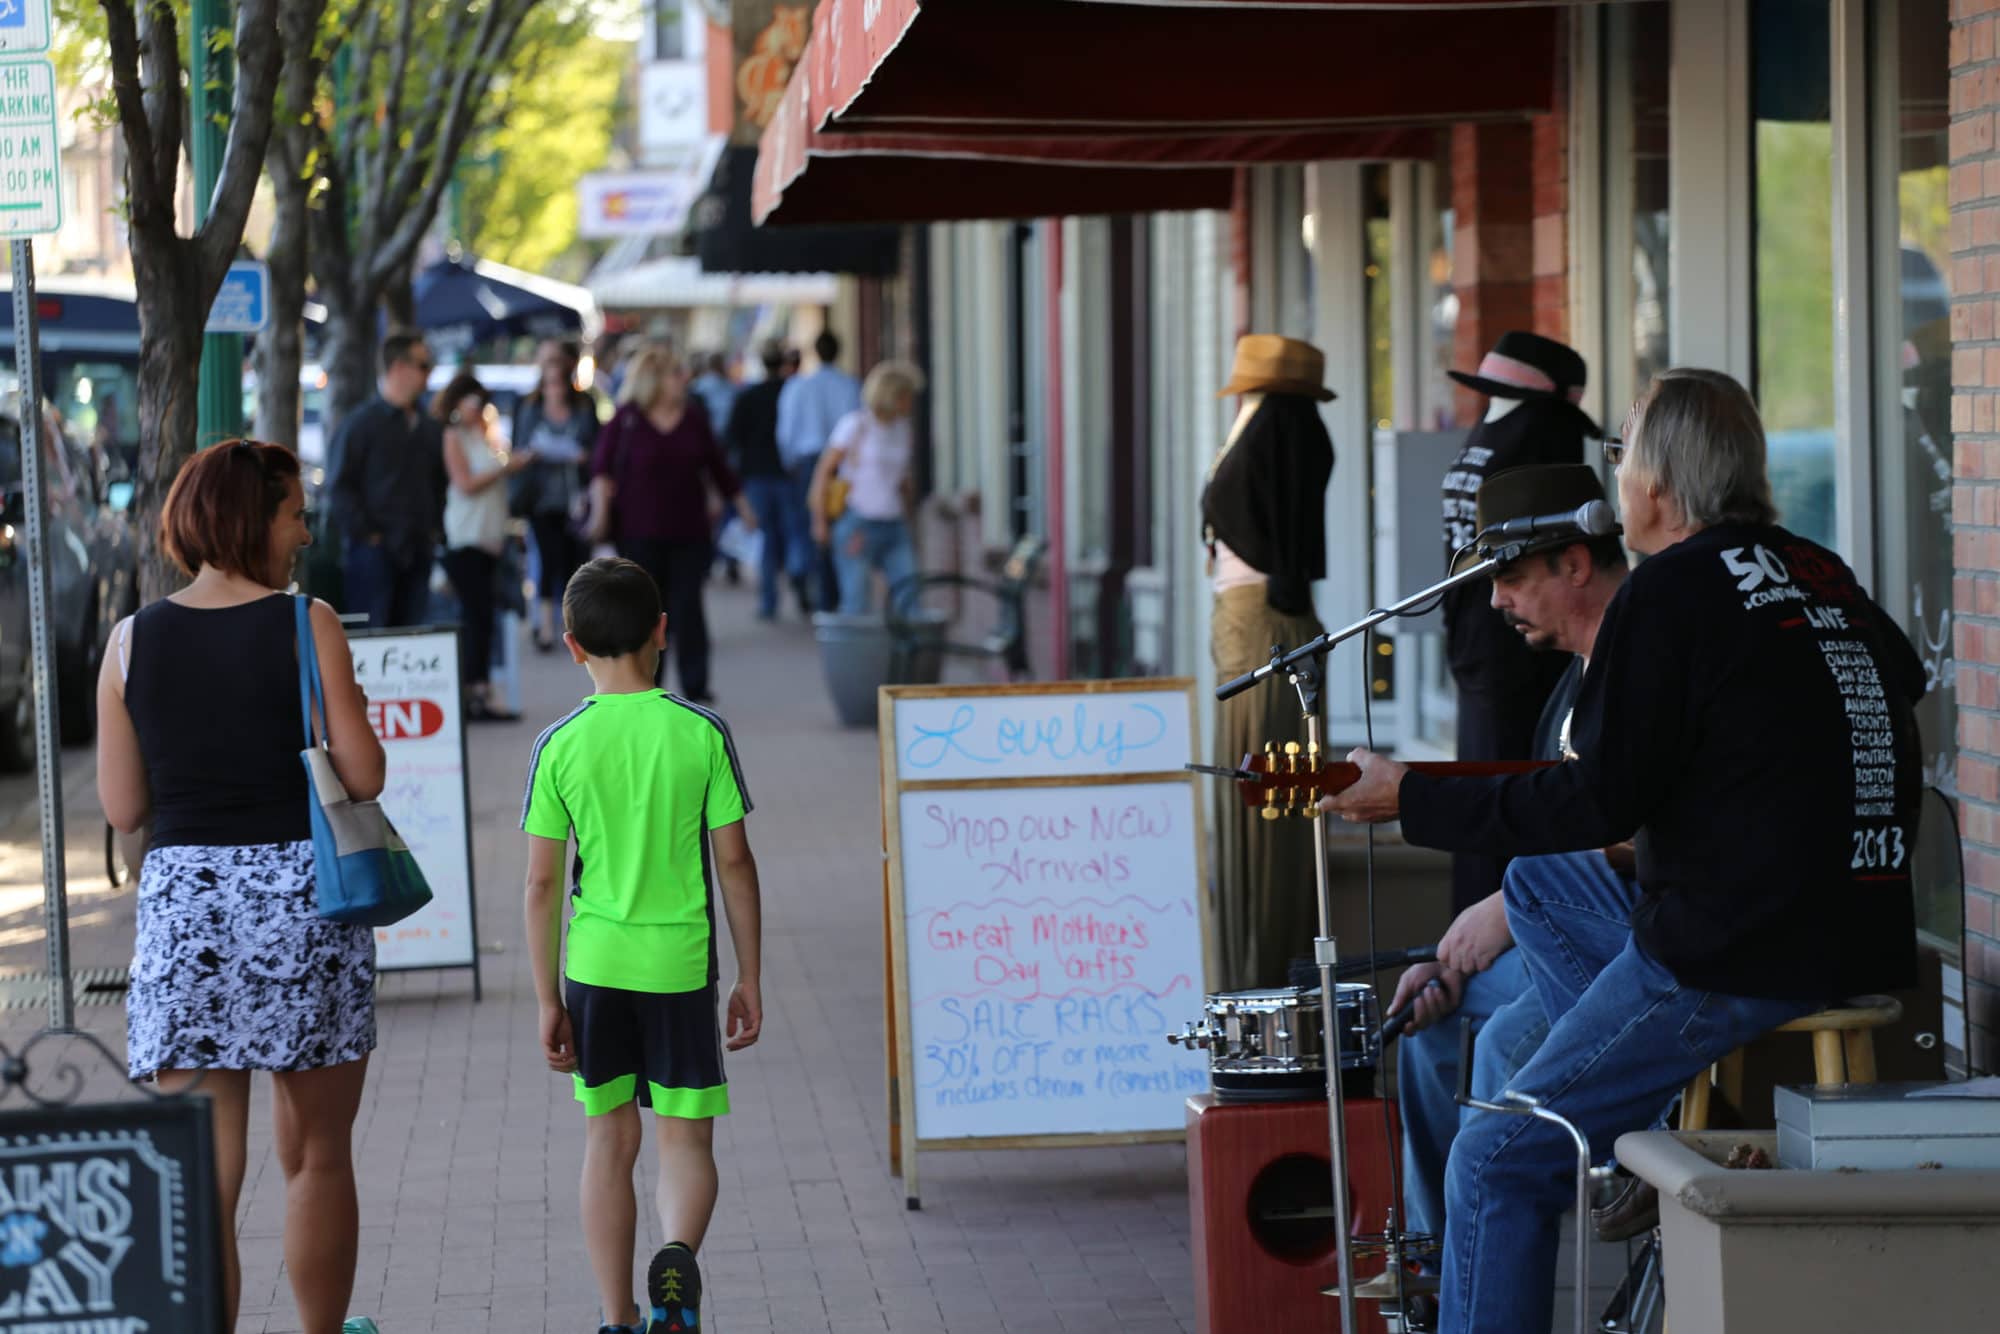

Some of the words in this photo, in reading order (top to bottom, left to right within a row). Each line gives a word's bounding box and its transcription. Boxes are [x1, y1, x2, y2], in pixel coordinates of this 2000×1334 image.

[20, 136, 41, 157] AM
[32, 168, 53, 189] PM
[1719, 544, 1790, 592] 50
[1803, 605, 1849, 630] LIVE
[381, 646, 443, 676] Fire
[1825, 653, 1874, 667] OAKLAND
[1832, 668, 1855, 683] SAN
[1854, 667, 1880, 684] JOSE
[1839, 684, 1855, 695] LAS
[1856, 684, 1885, 698] VEGAS
[1845, 698, 1888, 713] ANAHEIM
[1847, 714, 1891, 730] TORONTO
[905, 703, 1167, 769] Lovely
[1851, 731, 1893, 746] CHICAGO
[1853, 748, 1896, 765] MONTREAL
[1855, 767, 1895, 784] BOSTON
[922, 804, 1010, 859] Shop
[1018, 815, 1079, 842] our
[1851, 825, 1905, 870] 2013
[980, 848, 1132, 891] Arrivals
[928, 911, 1015, 958] Great
[974, 954, 1041, 996] Day
[931, 998, 1040, 1044] SALE
[1055, 994, 1167, 1037] RACKS
[920, 1043, 980, 1088] 30%
[992, 1040, 1055, 1076] OFF
[1063, 1046, 1083, 1066] or
[936, 1076, 1019, 1106] includes
